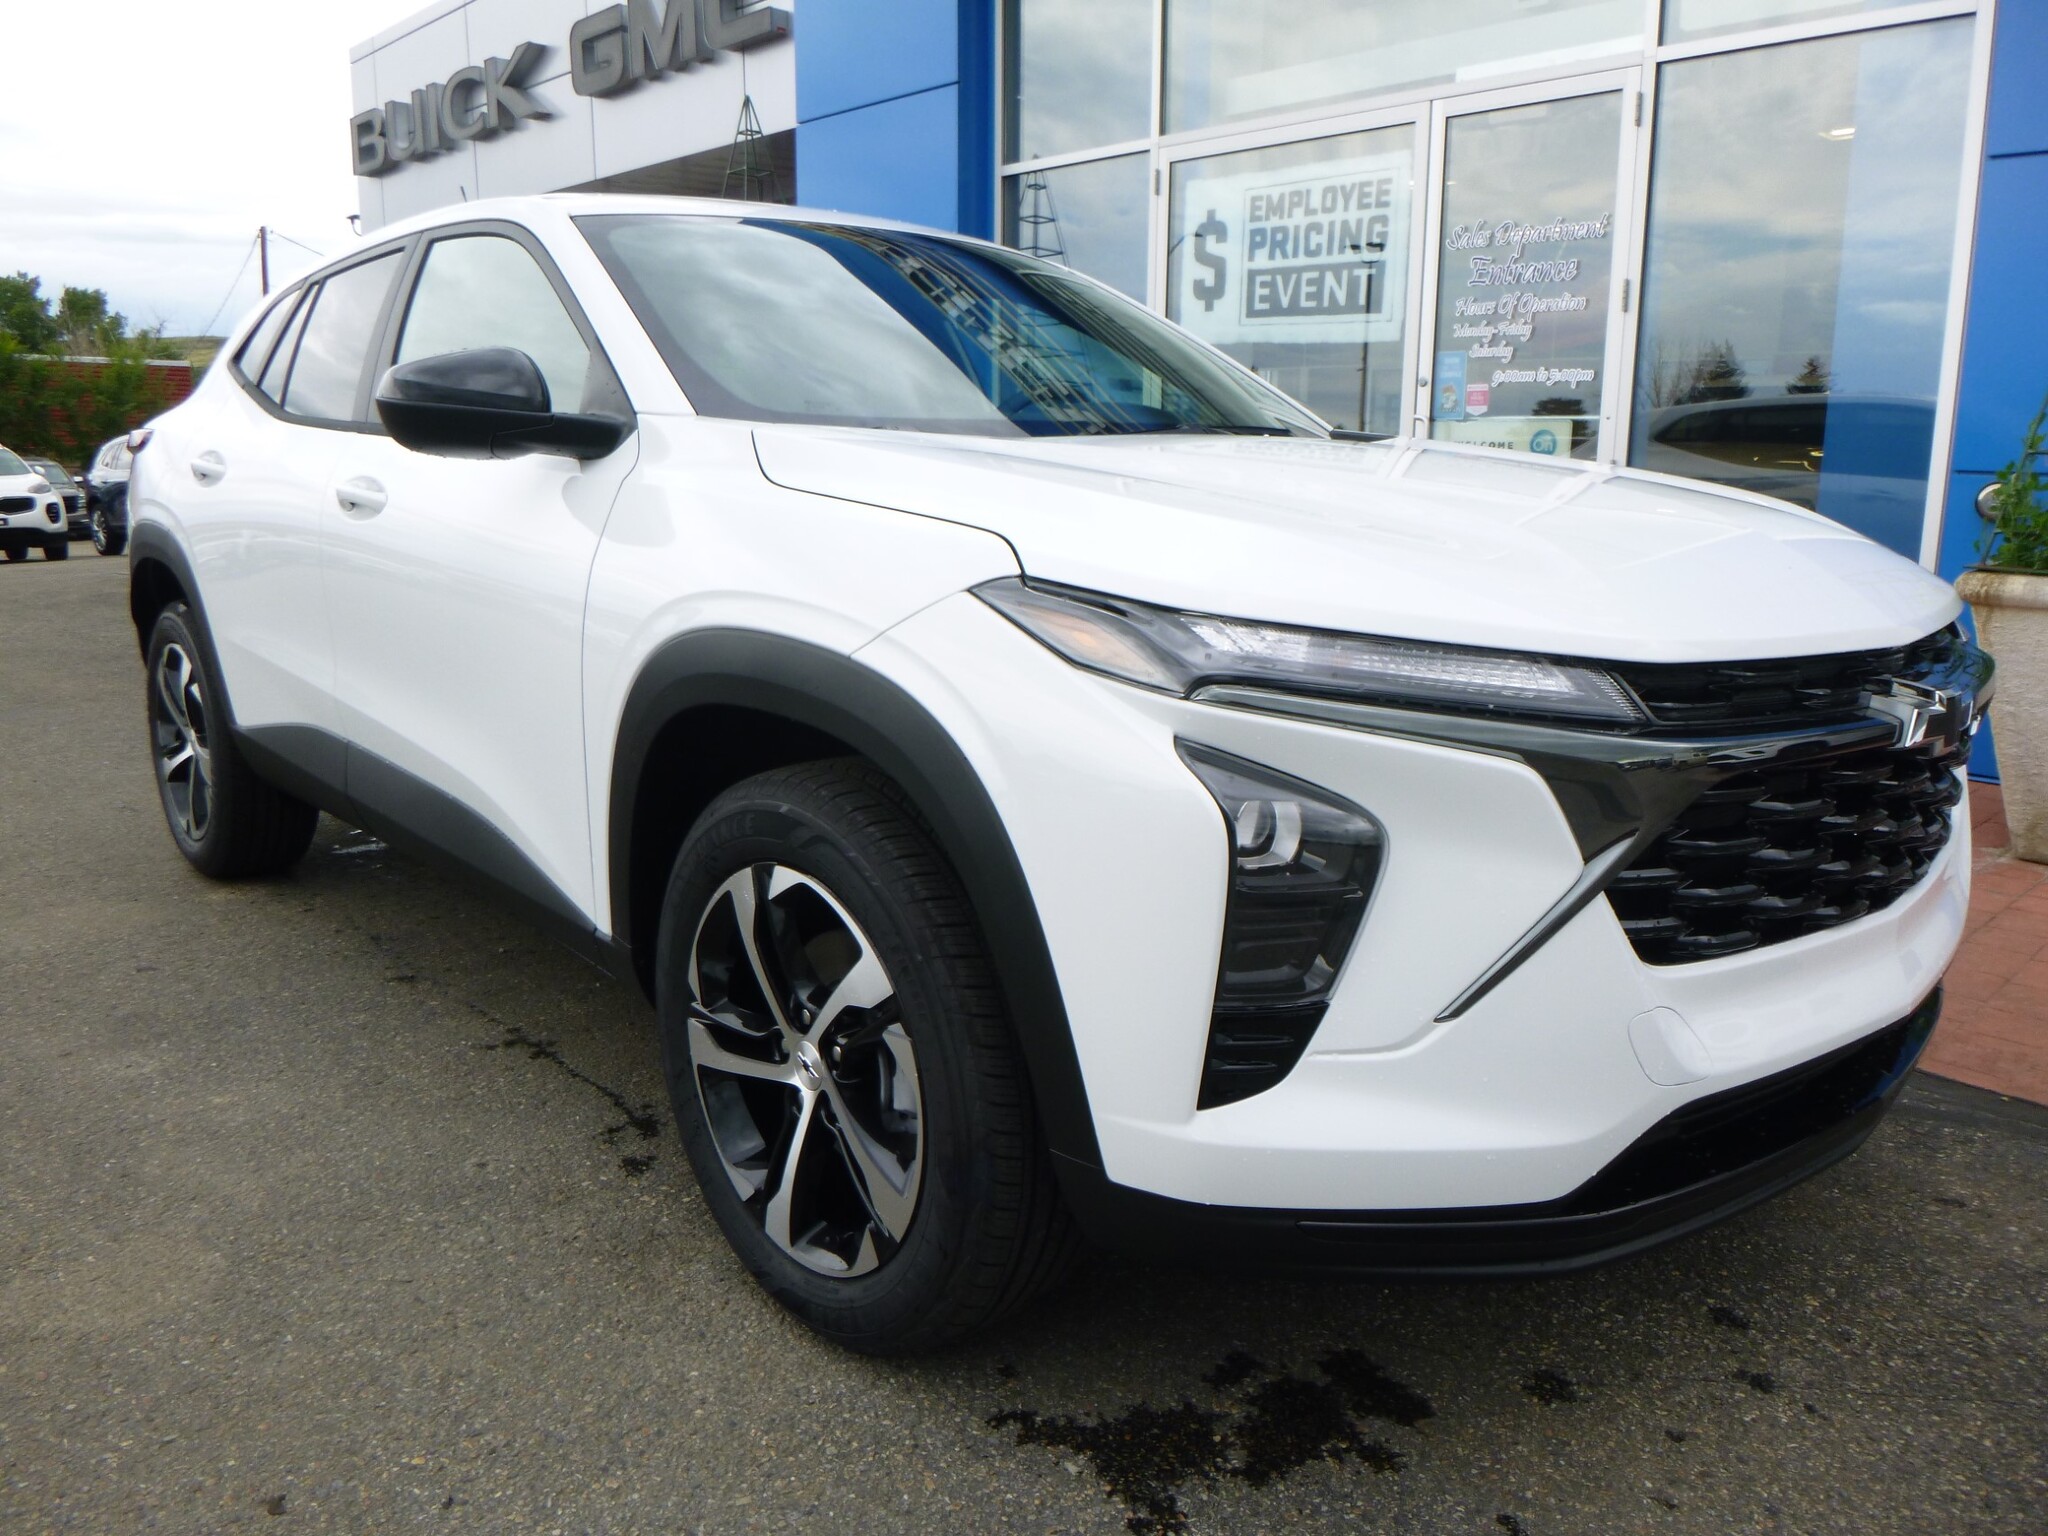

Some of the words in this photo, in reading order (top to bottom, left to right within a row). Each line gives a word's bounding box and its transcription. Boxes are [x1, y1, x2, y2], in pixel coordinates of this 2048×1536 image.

[350, 41, 553, 175] BUICK
[569, 0, 790, 97] GMC
[1249, 178, 1393, 223] EMPLOYEE
[1248, 214, 1389, 262] PRICING
[1446, 220, 1491, 250] Sales
[1496, 213, 1608, 257] Department
[1468, 254, 1578, 286] Entrance
[1253, 268, 1377, 310] EVENT
[1456, 297, 1496, 316] Hours
[1498, 292, 1520, 319] Of
[1519, 292, 1587, 321] Operation
[1454, 319, 1532, 342] Monday-Friday
[1469, 340, 1514, 363] Saturday
[1536, 366, 1549, 382] to
